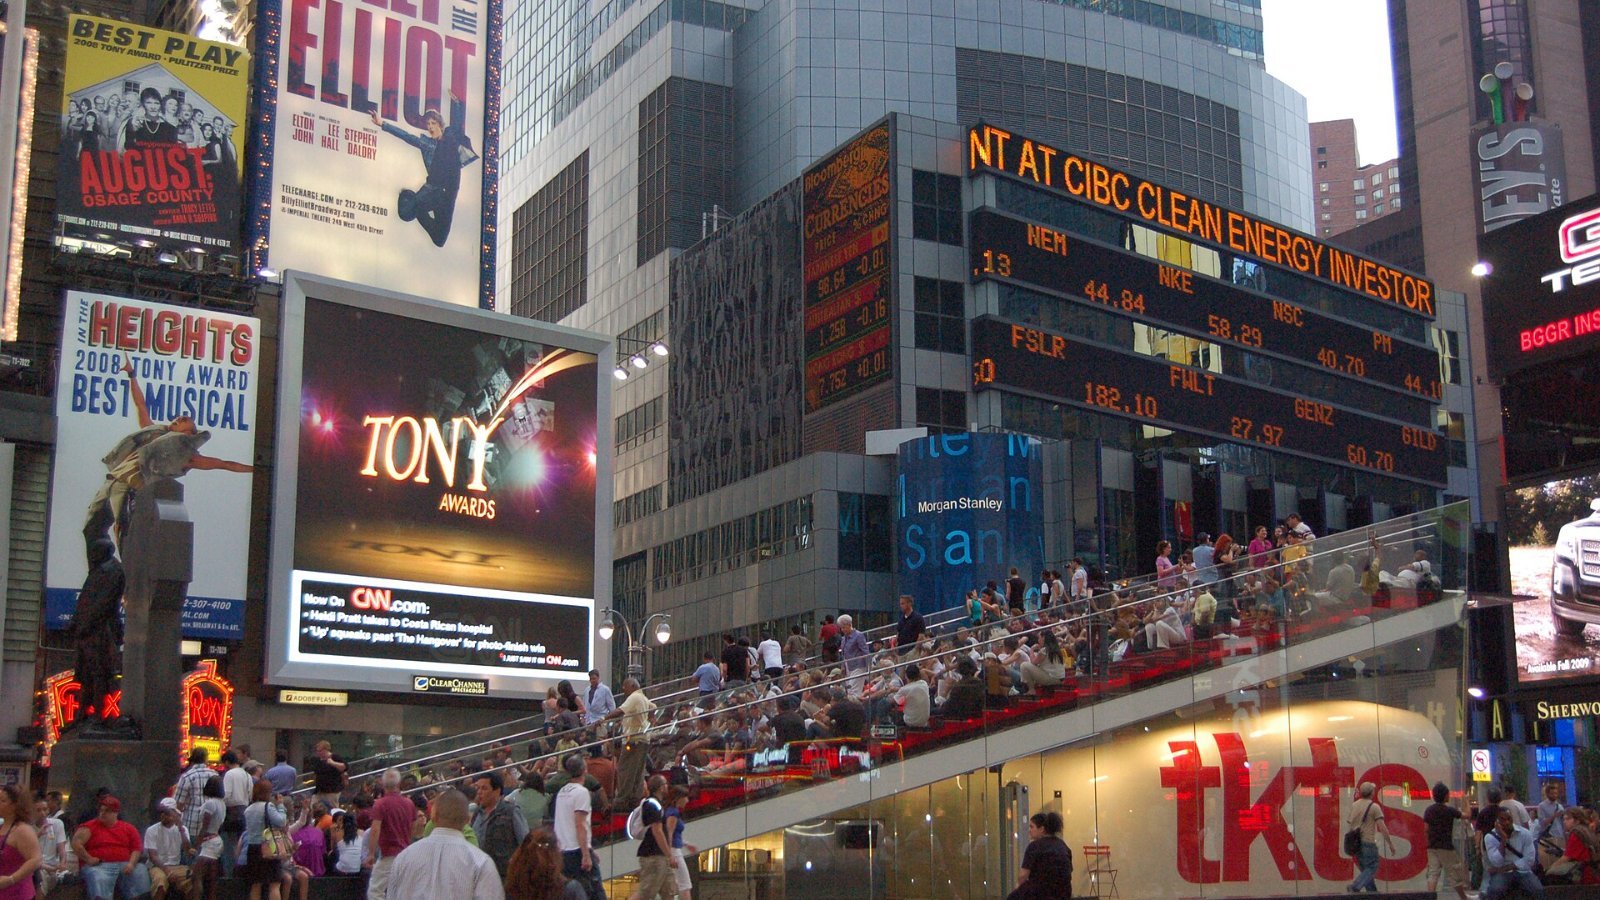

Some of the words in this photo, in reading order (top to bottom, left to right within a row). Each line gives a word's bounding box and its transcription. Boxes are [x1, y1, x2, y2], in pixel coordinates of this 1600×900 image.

[452, 6, 477, 35] THE
[72, 19, 155, 50] BEST
[163, 37, 242, 67] PLAY
[73, 38, 98, 48] 2008
[101, 43, 126, 55] TONY
[127, 49, 162, 61] AWARD
[169, 57, 211, 71] PULITZER
[213, 66, 239, 77] PRIZE
[287, 0, 476, 137] ELLIOT
[292, 114, 314, 131] ELTON
[292, 128, 314, 144] JOHN
[328, 124, 340, 138] LEE
[321, 135, 339, 151] HALL
[344, 128, 377, 147] STEPHEN
[80, 147, 213, 195] AUGUST:
[83, 191, 141, 207] OSAGE
[146, 188, 214, 204] COUNTY
[281, 184, 334, 204] TELECHARGE.COM
[804, 172, 890, 241] CURRENCIES
[311, 211, 331, 223] THEATRE
[970, 125, 1010, 170] NT
[1018, 139, 1056, 186] AT
[1064, 156, 1130, 211] CIBC
[1137, 181, 1222, 244] CLEAN
[1227, 212, 1324, 277] ENERGY
[1329, 248, 1433, 316] INVESTOR
[1027, 223, 1067, 256] NEM
[1158, 264, 1195, 295] NKE
[1084, 279, 1146, 315] 44.84
[80, 298, 89, 327] THE
[1273, 299, 1304, 327] NSC
[78, 329, 87, 343] IN
[88, 301, 253, 366] HEIGHTS
[1011, 324, 1066, 360] FSLR
[1207, 314, 1263, 348] 58.29
[1373, 329, 1392, 355] PM
[1520, 318, 1571, 352] BGGR
[75, 350, 120, 375] 2008
[132, 357, 176, 381] TONY
[187, 364, 248, 391] AWARD
[1317, 348, 1365, 377] 40.70
[1169, 365, 1215, 396] FWLT
[72, 374, 130, 417] BEST
[145, 382, 248, 431] MUSICAL
[1085, 381, 1158, 419] 182.10
[1294, 398, 1334, 426] GENZ
[1230, 417, 1284, 447] 27.97
[1402, 425, 1437, 451] GILD
[361, 415, 504, 491] TONY
[439, 493, 496, 520] AWARDS
[918, 499, 957, 514] Morgan
[959, 497, 1003, 512] Stanley
[304, 593, 328, 606] Now
[329, 595, 345, 607] On
[310, 609, 336, 621] Heidi
[337, 612, 361, 623] Pratt
[362, 615, 389, 626] taken
[390, 617, 400, 626] to
[401, 618, 429, 629] Costa
[430, 620, 457, 632] Rican
[458, 622, 493, 635] hospital
[330, 629, 371, 640] squeaks
[371, 632, 394, 642] past
[463, 638, 477, 648] for
[477, 639, 529, 652] photo-finish
[530, 643, 546, 654] win
[1527, 661, 1557, 673] Available
[1557, 660, 1570, 671] Fall
[1571, 658, 1589, 669] 2009
[1159, 732, 1432, 884] tkts
